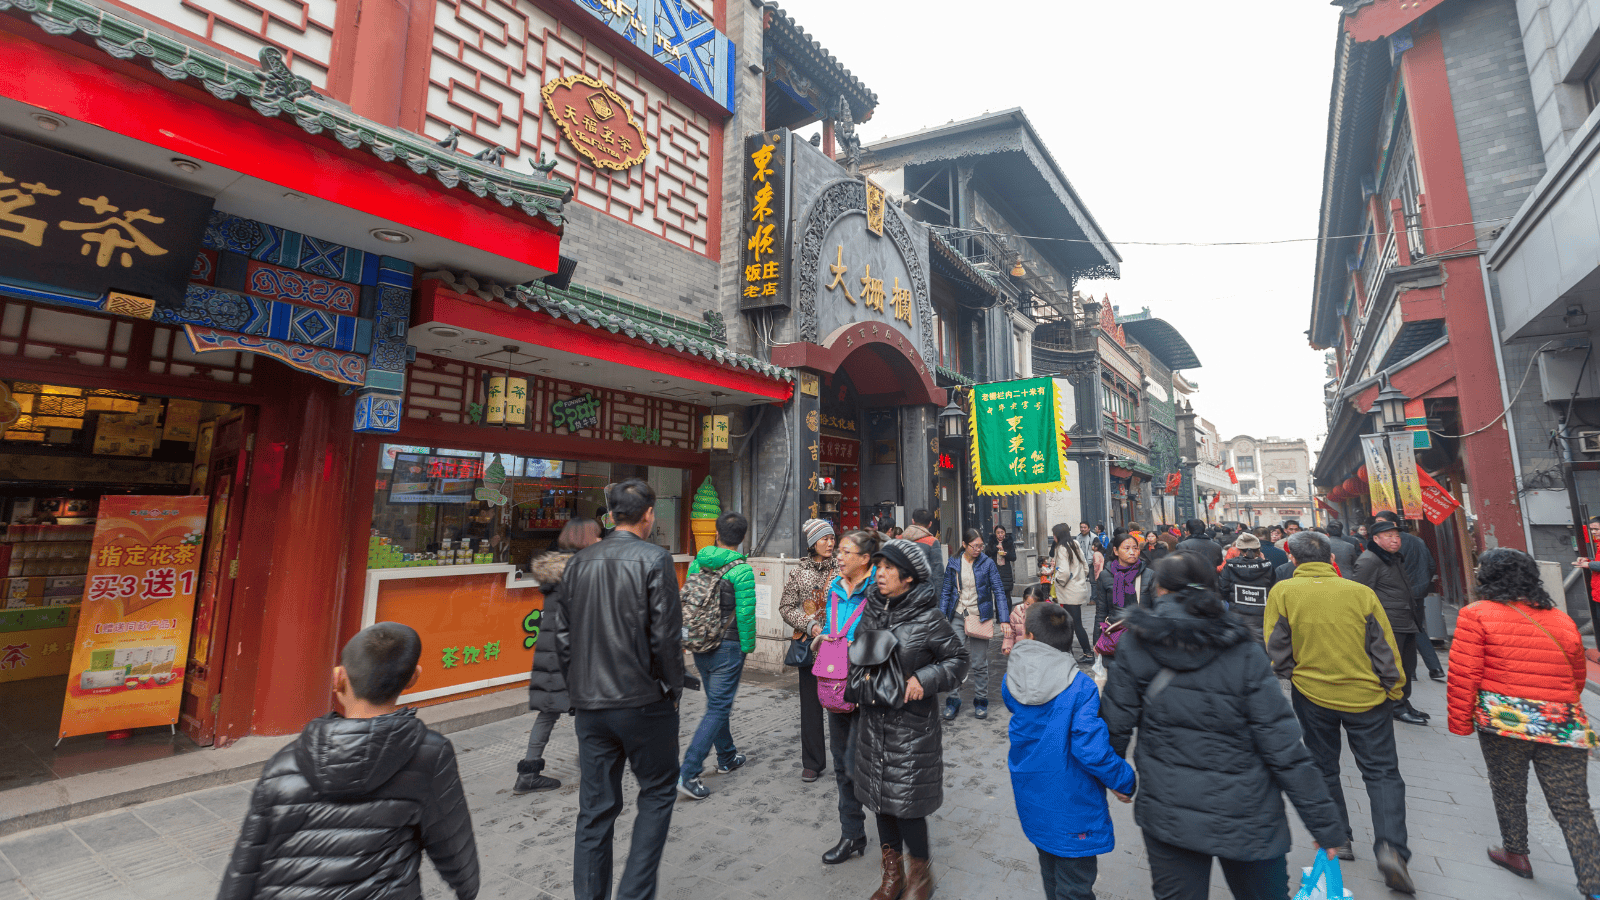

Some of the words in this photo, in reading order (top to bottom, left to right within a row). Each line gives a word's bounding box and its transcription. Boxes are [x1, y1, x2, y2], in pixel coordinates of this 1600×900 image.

[655, 31, 681, 60] TEA
[743, 281, 779, 298] 老店
[511, 385, 526, 399] 茶
[98, 543, 196, 567] 指定花茶
[1241, 588, 1260, 597] School
[1244, 595, 1257, 603] kills
[442, 640, 501, 669] 茶饮料
